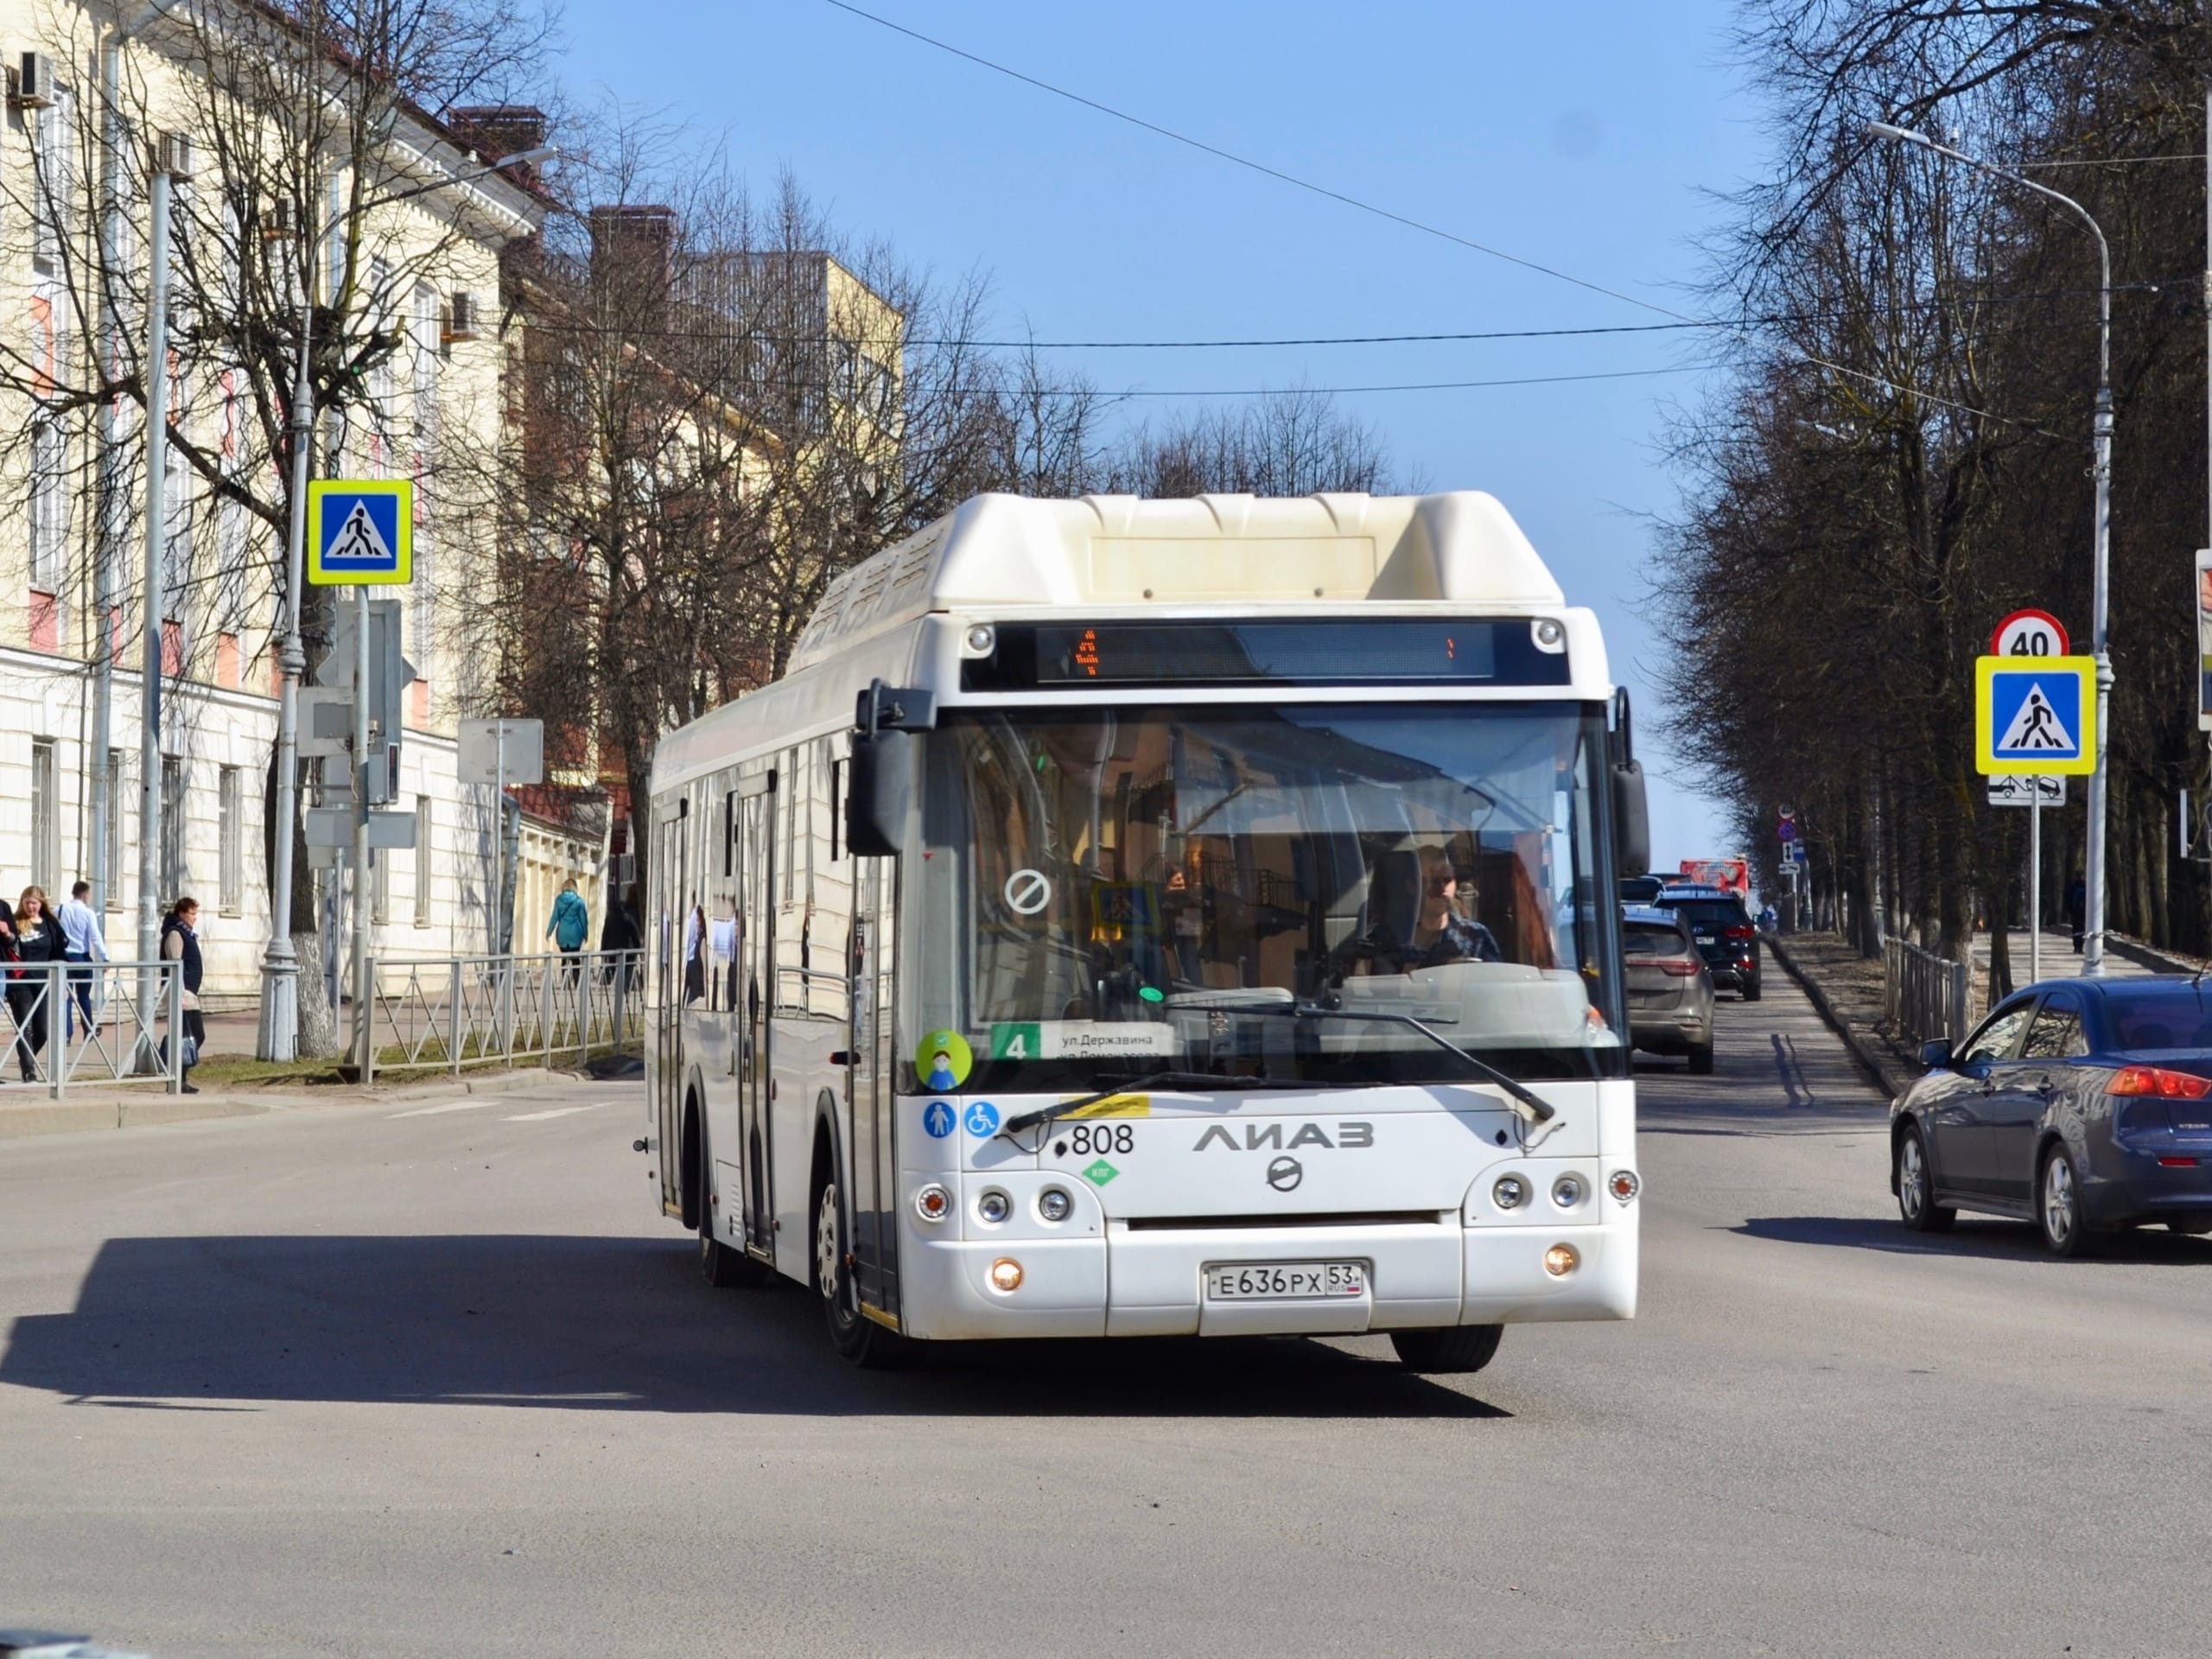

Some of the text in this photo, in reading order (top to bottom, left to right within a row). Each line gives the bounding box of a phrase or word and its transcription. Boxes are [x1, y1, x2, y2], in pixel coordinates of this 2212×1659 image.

[1076, 630, 1098, 675] 4
[2010, 632, 2049, 657] 40
[1005, 1034, 1027, 1058] 4
[1062, 1034, 1153, 1048] ул.Державина
[1072, 1124, 1134, 1155] 808
[1192, 1122, 1374, 1151] ЛИАЗ
[1329, 1266, 1353, 1285] 53
[1327, 1284, 1346, 1293] RUS
